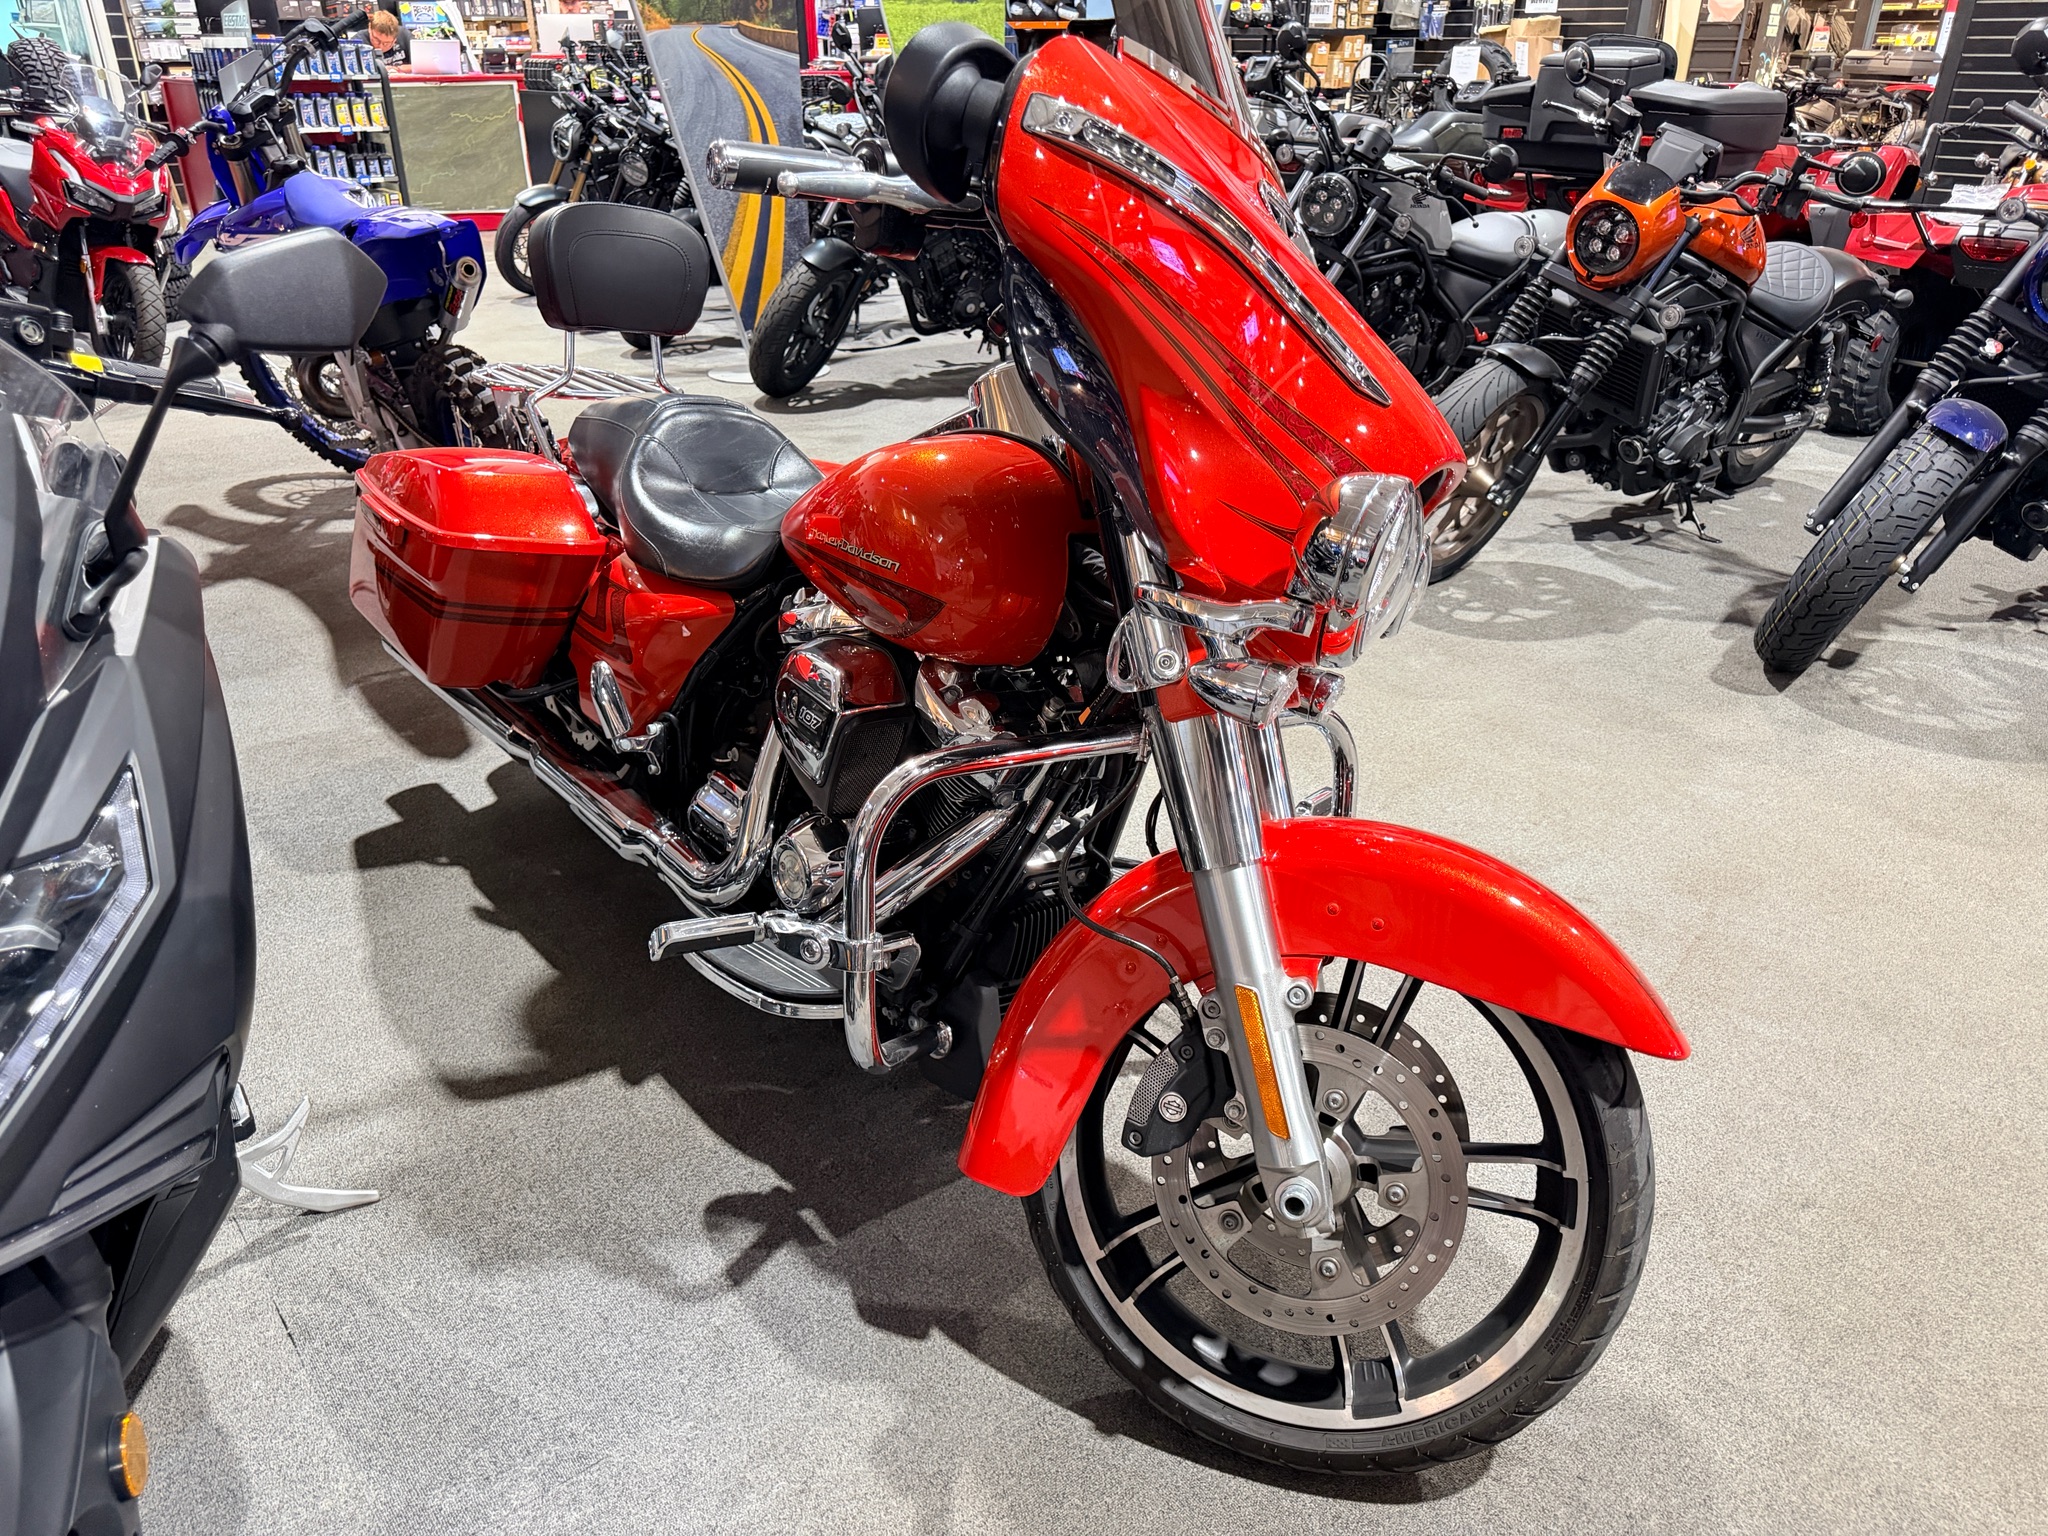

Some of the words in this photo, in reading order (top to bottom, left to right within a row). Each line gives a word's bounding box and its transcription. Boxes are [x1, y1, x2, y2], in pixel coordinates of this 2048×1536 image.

[811, 527, 900, 573] Harley-Davidson
[798, 705, 822, 730] 107
[1380, 1401, 1487, 1448] AMERICAN
